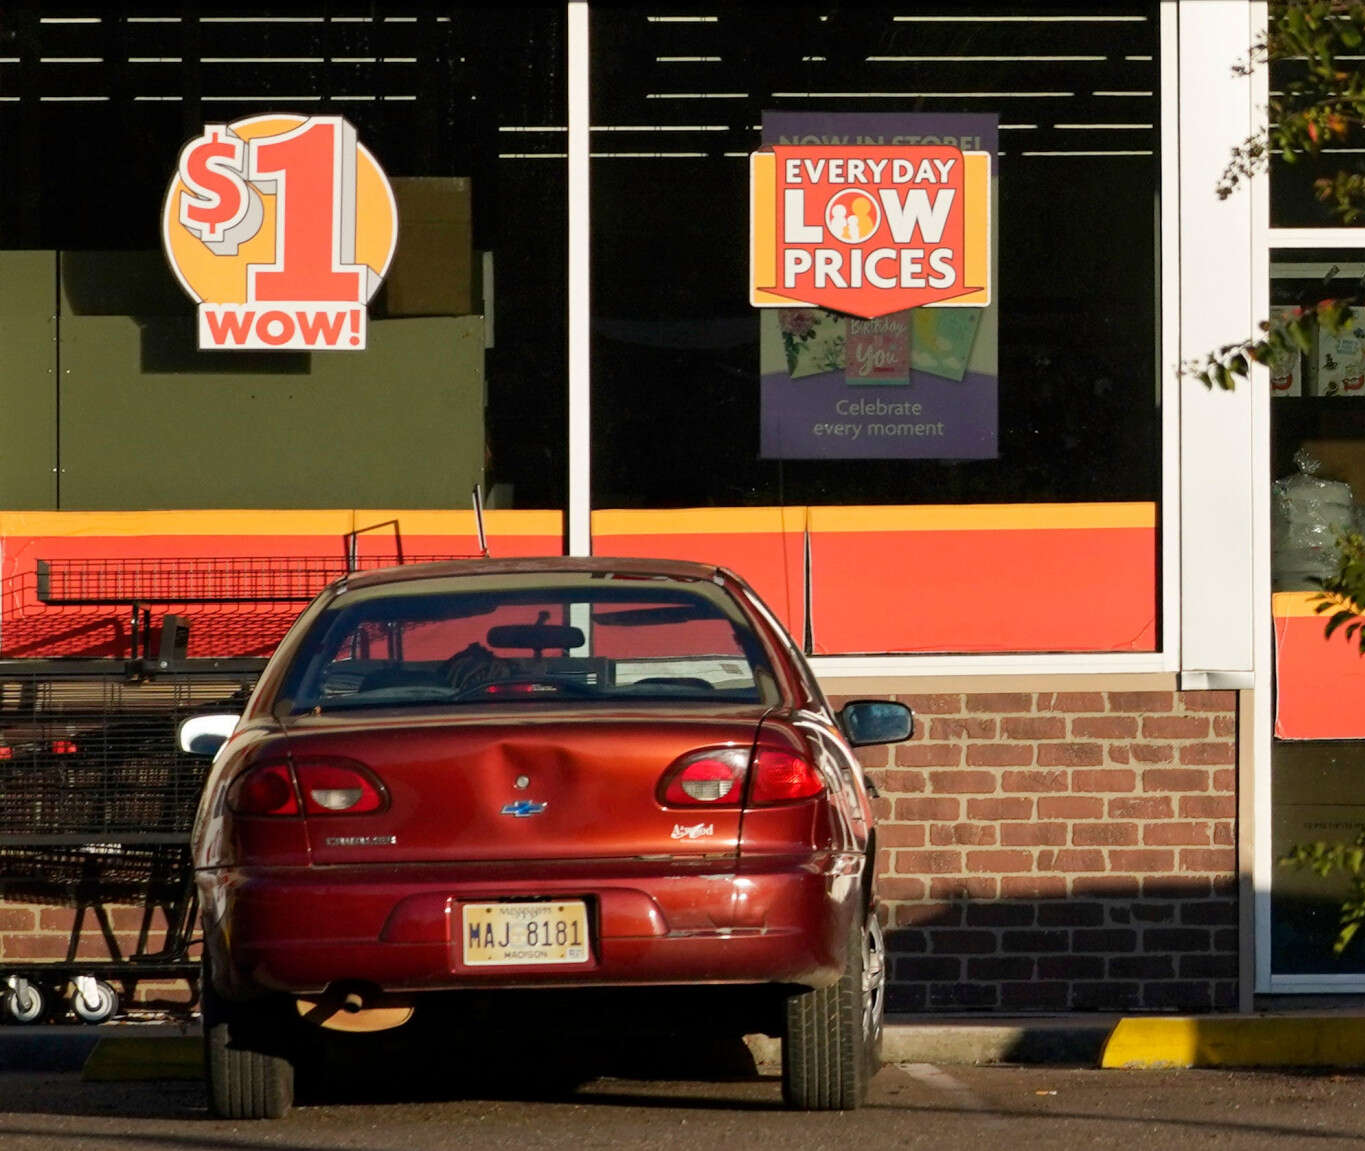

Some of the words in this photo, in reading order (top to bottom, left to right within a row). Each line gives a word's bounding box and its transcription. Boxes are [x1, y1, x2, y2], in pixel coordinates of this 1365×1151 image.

[784, 188, 956, 244] LOW
[784, 248, 956, 289] PRICES
[204, 309, 361, 347] WOW!
[835, 399, 922, 416] Celebrate
[813, 425, 861, 440] every
[867, 422, 944, 437] moment
[468, 921, 511, 949] MAJ
[526, 919, 582, 947] 8181
